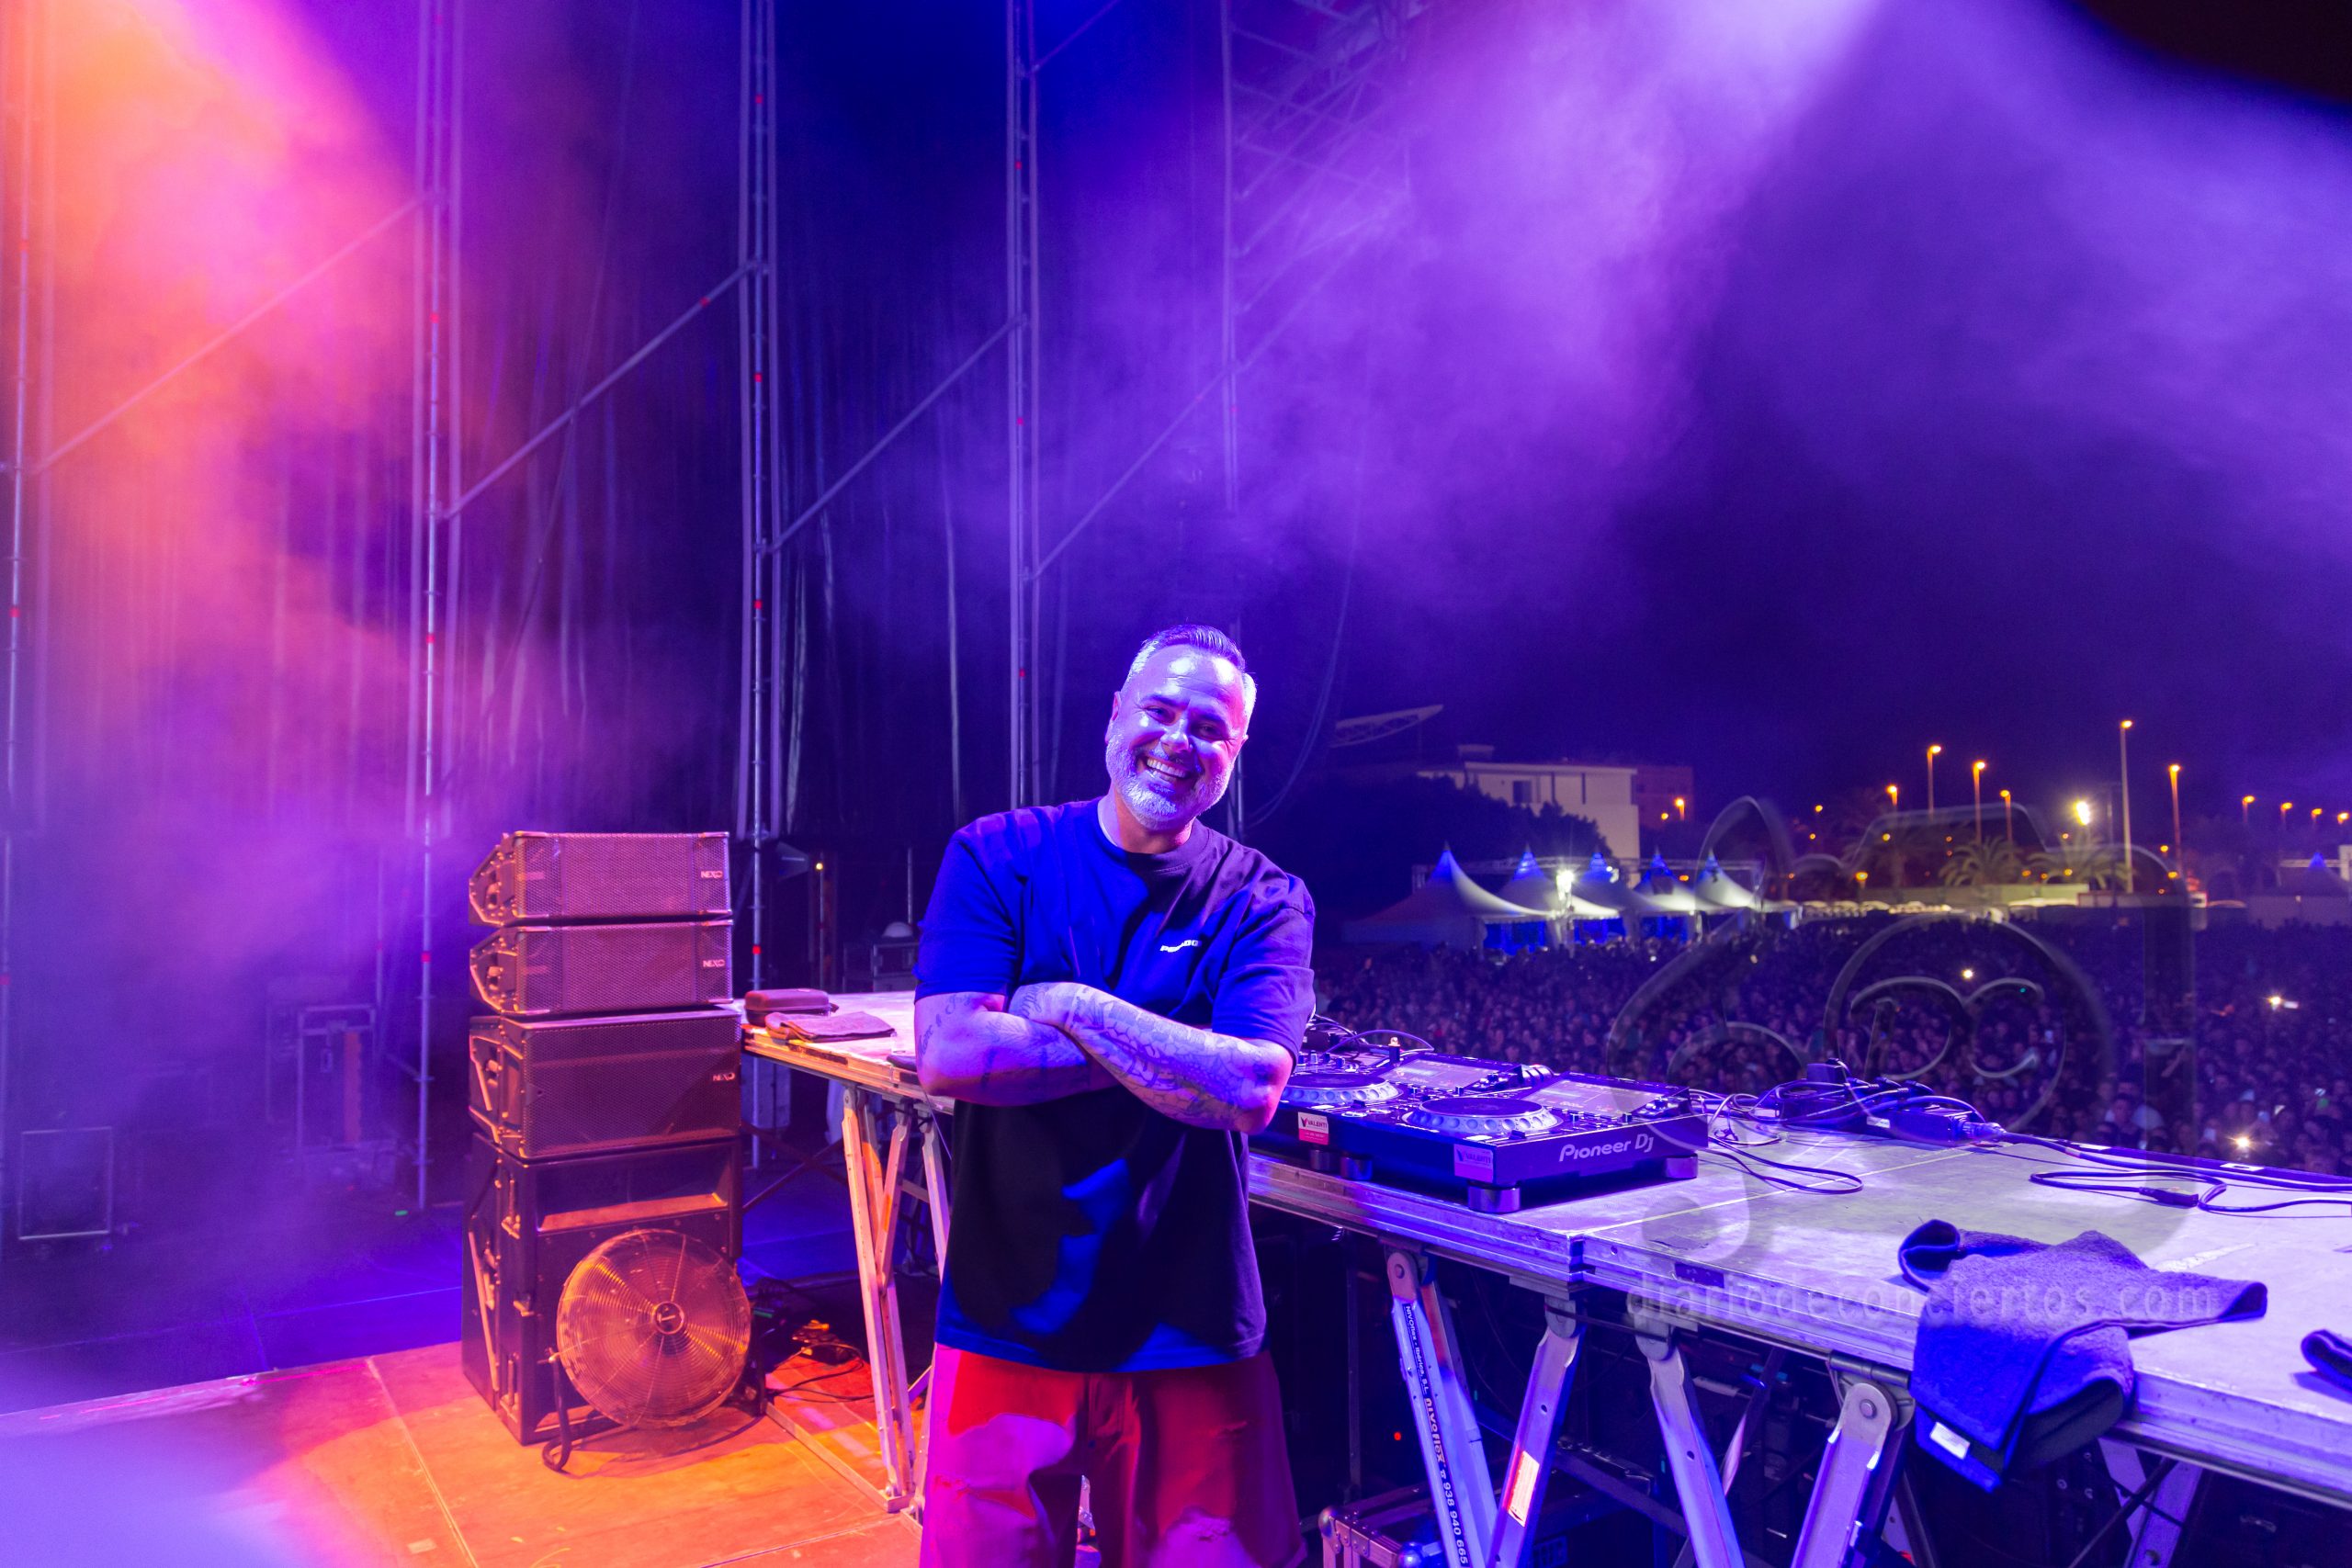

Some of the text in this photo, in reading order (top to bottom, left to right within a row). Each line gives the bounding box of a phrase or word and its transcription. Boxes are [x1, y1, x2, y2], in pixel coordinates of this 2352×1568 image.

[700, 870, 723, 879] NEXO
[702, 959, 725, 968] NEXO
[1558, 1140, 1632, 1162] Pioneer
[1442, 1482, 1455, 1506] 938
[1449, 1511, 1462, 1536] 940
[1456, 1539, 1468, 1564] 665
